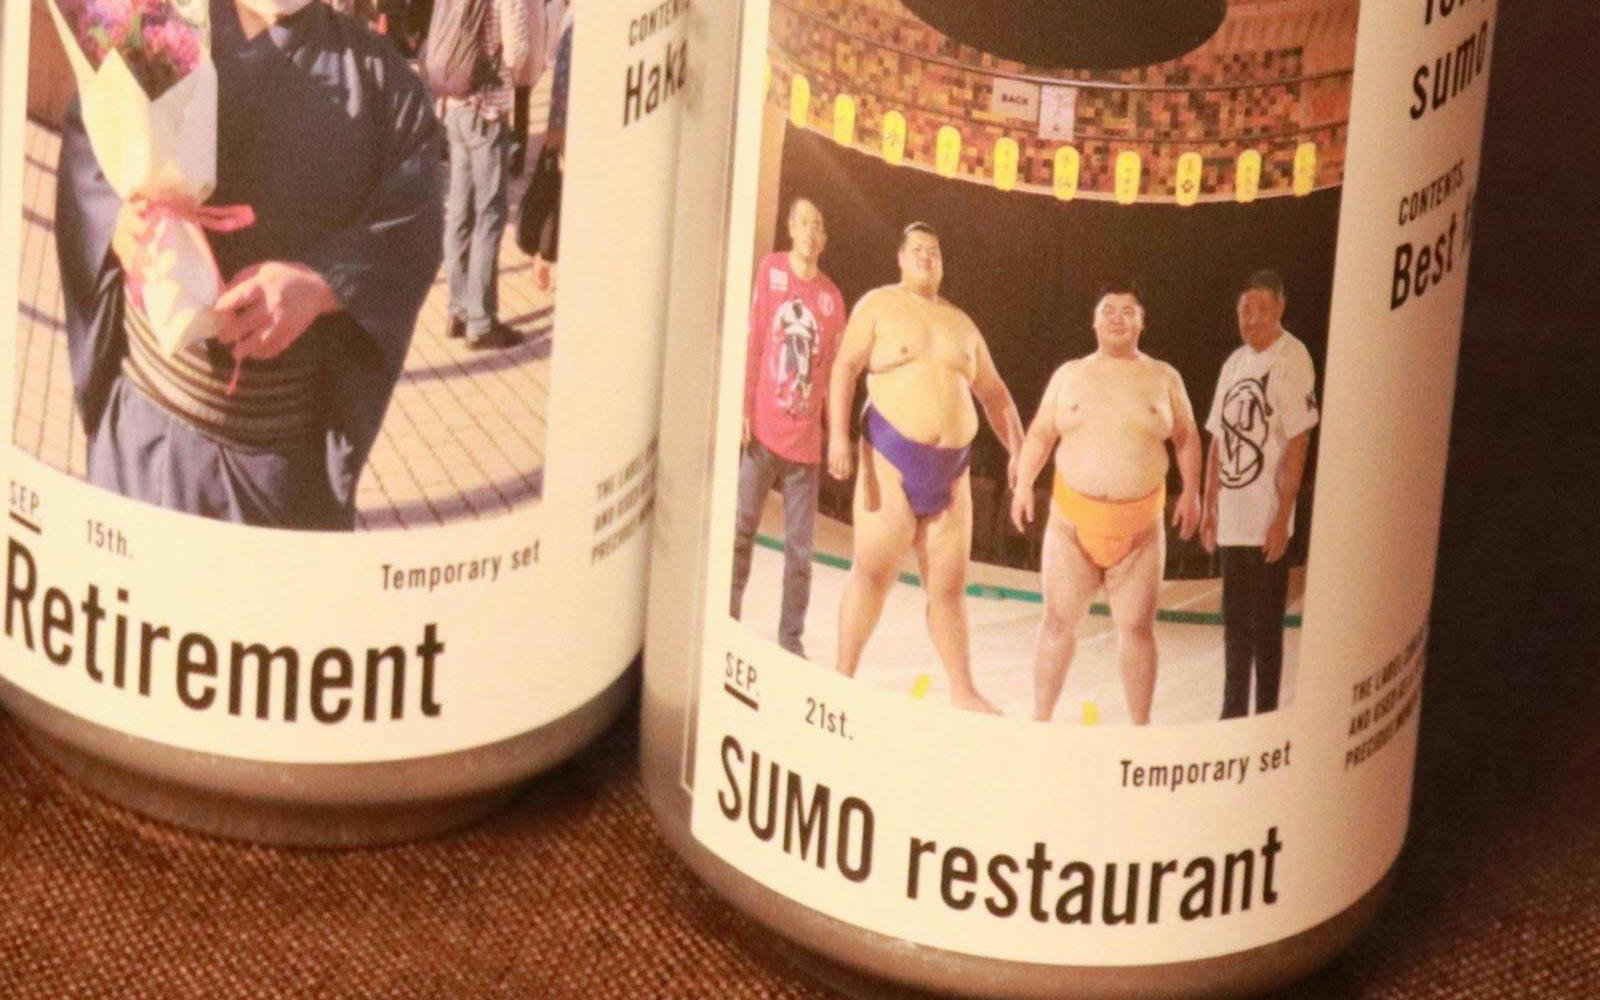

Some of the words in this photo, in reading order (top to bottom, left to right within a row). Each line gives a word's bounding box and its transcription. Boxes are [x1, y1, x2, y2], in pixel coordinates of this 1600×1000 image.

[1409, 19, 1488, 121] sumo
[1389, 211, 1458, 311] Best
[381, 550, 504, 593] Temporary
[511, 538, 543, 570] set
[4, 536, 446, 726] Retirement
[803, 693, 856, 742] 21st.
[1118, 751, 1252, 793] Temporary
[1258, 738, 1293, 778] set
[716, 734, 876, 885] SUMO
[906, 825, 1284, 929] restaurant
